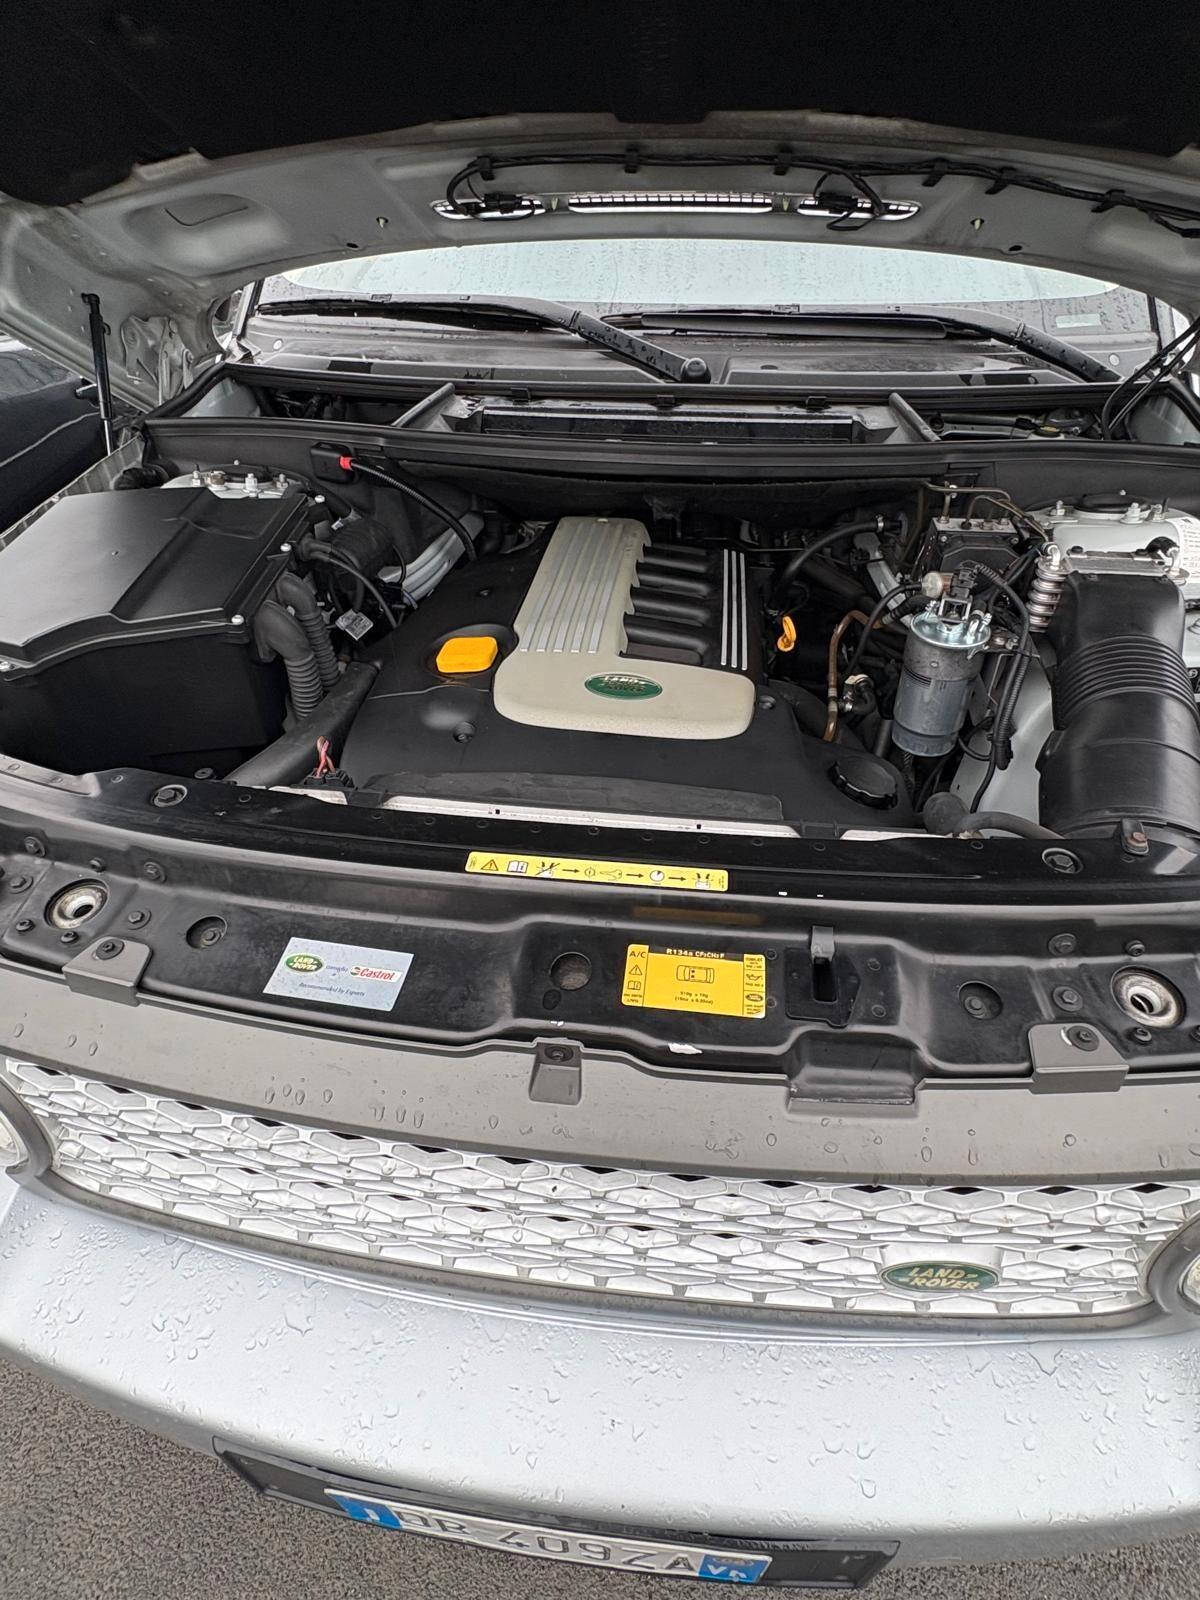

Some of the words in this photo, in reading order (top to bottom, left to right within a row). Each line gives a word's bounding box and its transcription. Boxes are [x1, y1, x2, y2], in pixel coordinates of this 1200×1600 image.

[629, 950, 646, 958] A/C
[666, 948, 693, 956] R134a
[360, 968, 396, 980] Castrol
[908, 1267, 966, 1279] LAND
[910, 1277, 981, 1290] ROVER
[498, 1530, 698, 1572] 409ZA
